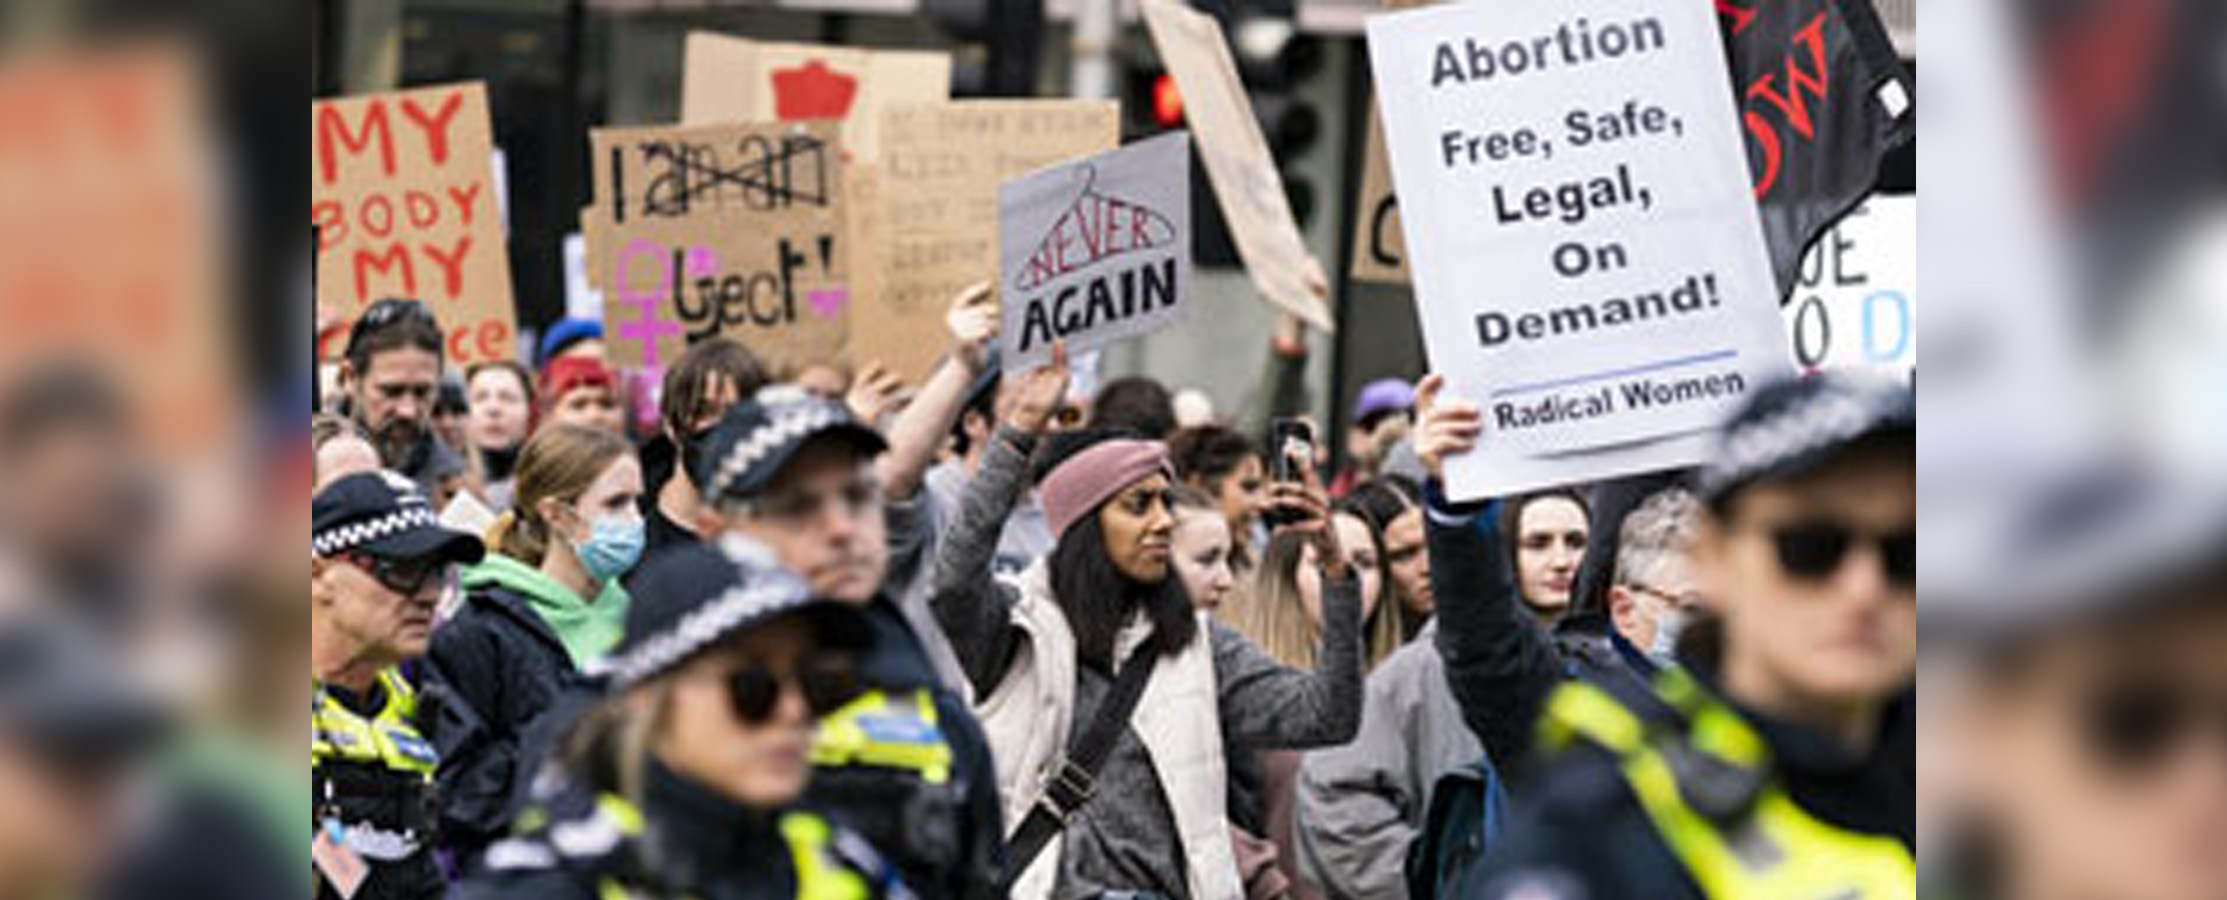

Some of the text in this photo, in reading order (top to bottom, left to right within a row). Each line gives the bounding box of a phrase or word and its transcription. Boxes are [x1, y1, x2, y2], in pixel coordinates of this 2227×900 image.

[1430, 16, 1664, 87] Abortion
[319, 90, 463, 184] MY
[1441, 101, 1684, 166] Free, Safe,
[611, 143, 625, 224] I
[1492, 165, 1651, 223] Legal,
[355, 235, 472, 302] MY
[1031, 193, 1152, 287] NEVER
[1552, 243, 1627, 278] On
[1018, 258, 1176, 352] AGAIN
[1476, 274, 1720, 347] Demand!
[1494, 371, 1745, 430] Radical Women
